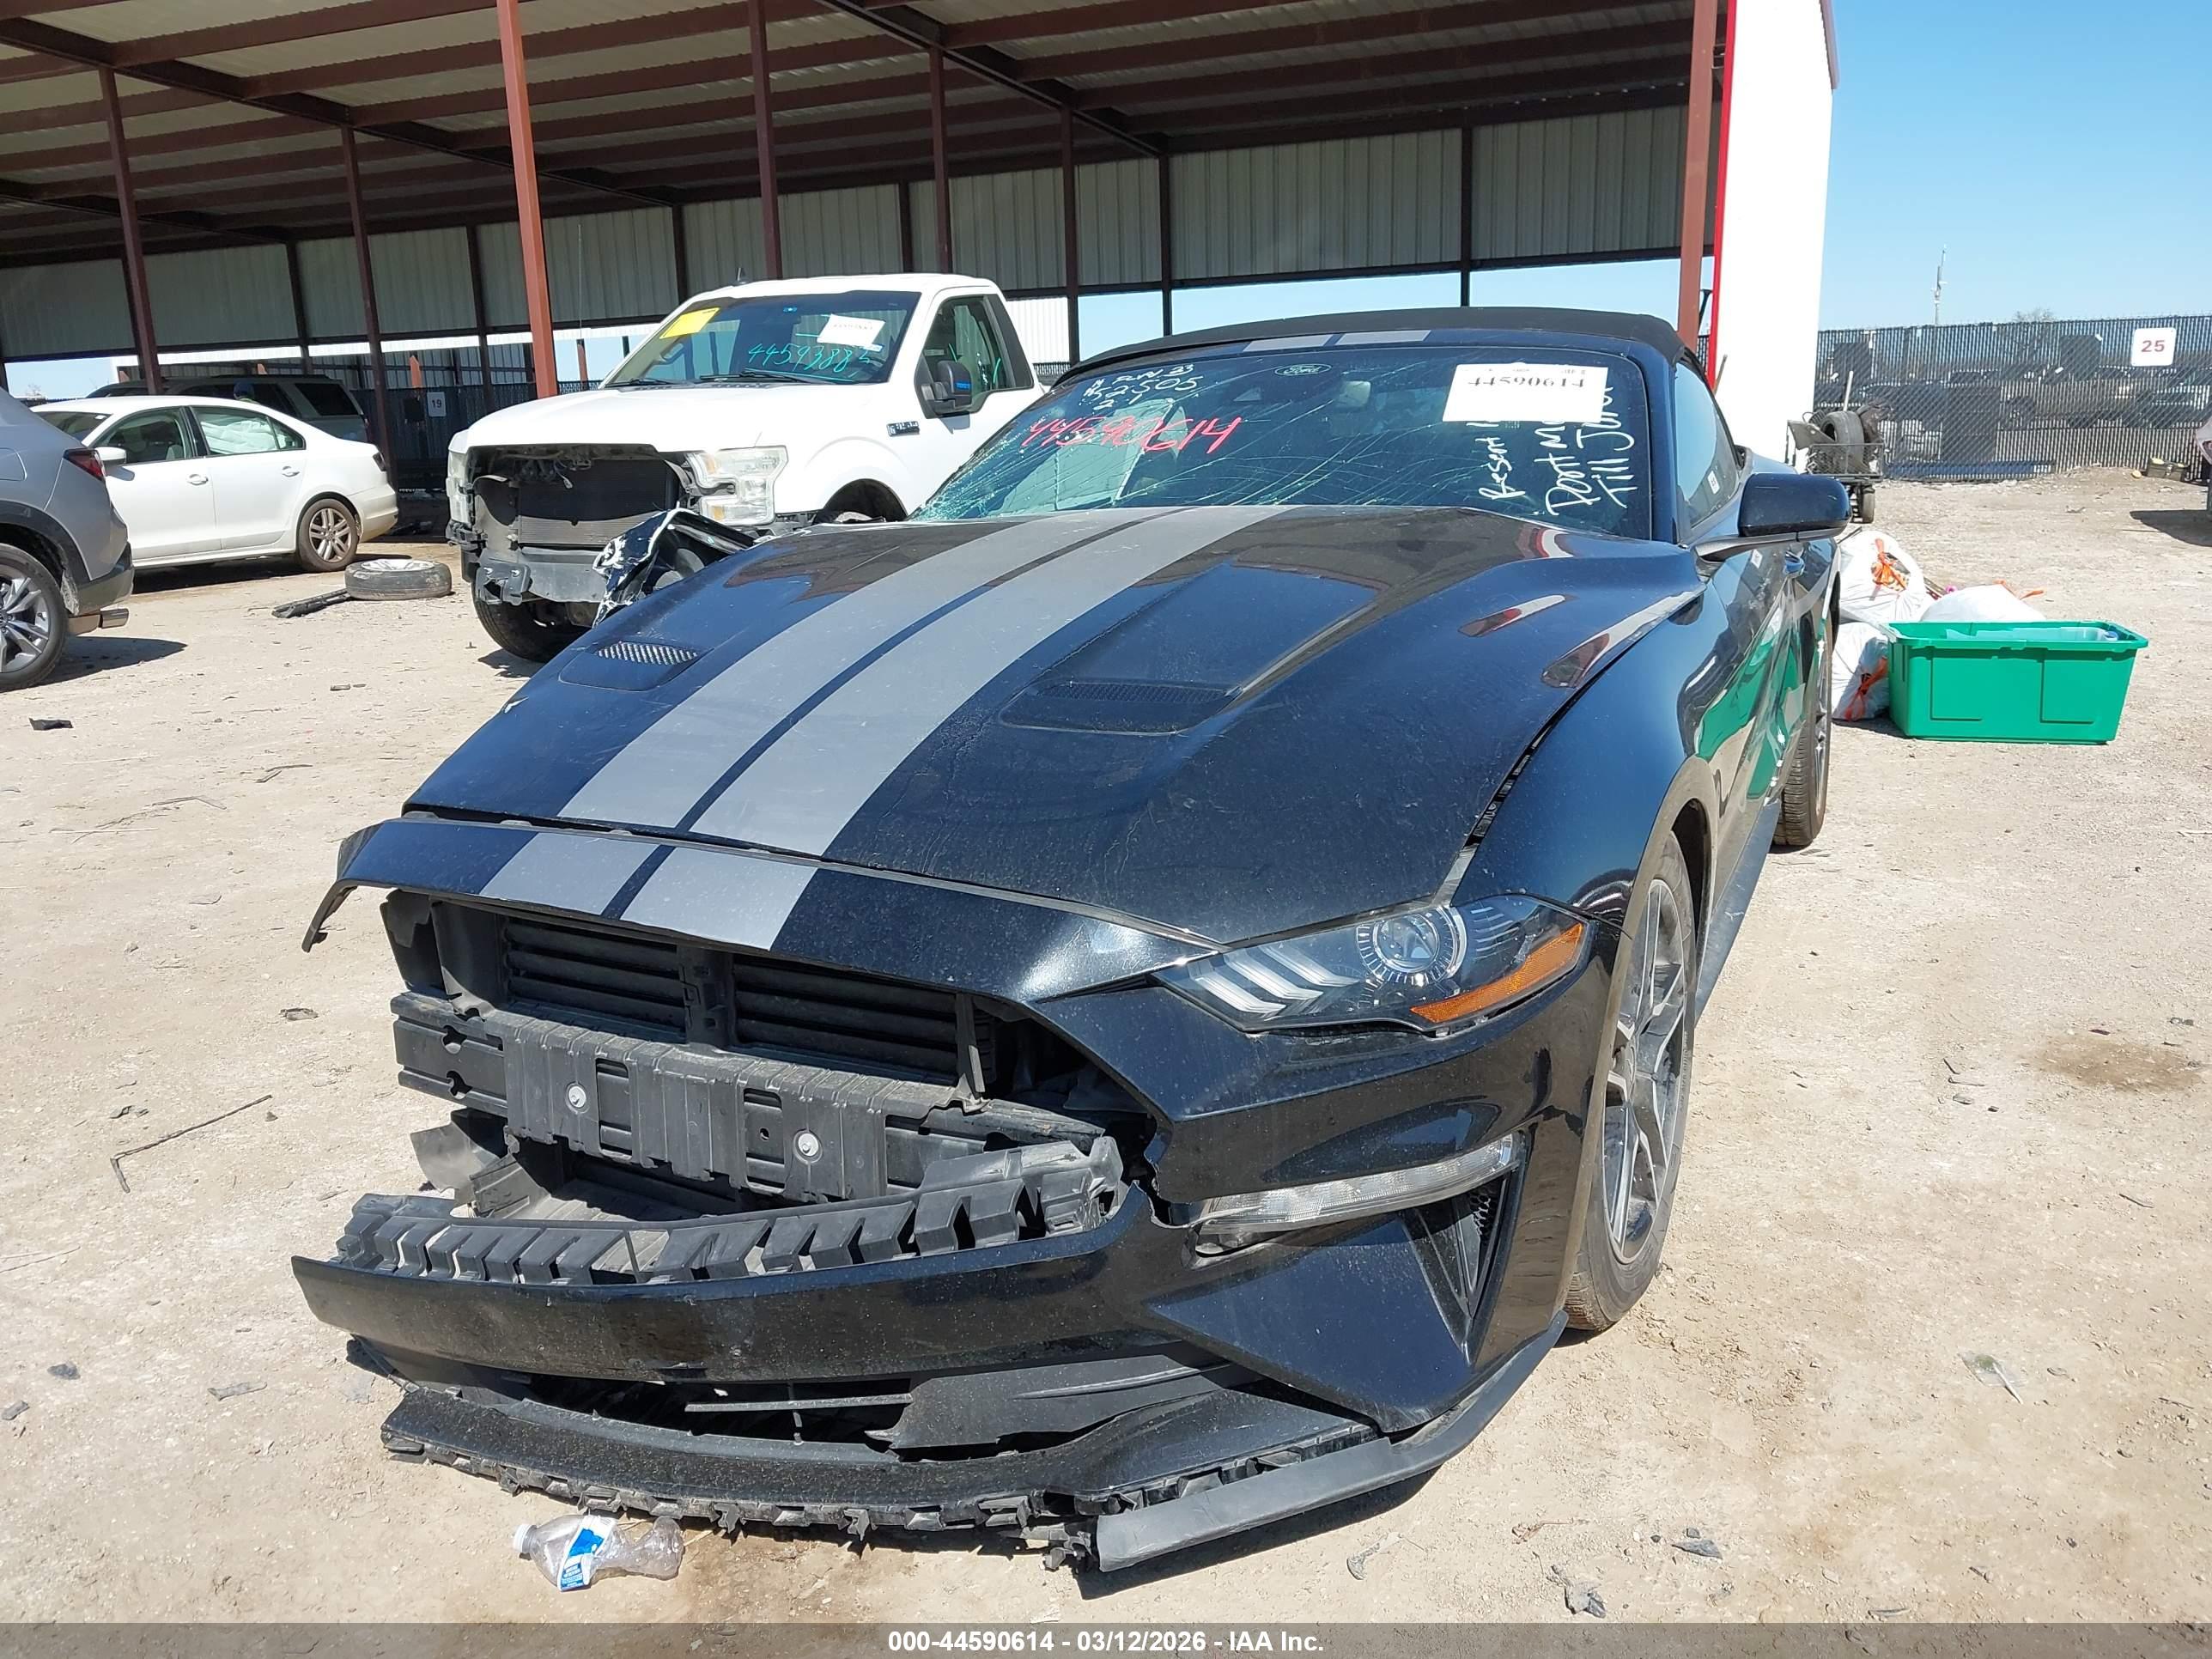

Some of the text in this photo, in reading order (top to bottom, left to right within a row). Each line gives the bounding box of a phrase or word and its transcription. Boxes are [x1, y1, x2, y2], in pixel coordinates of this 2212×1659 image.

[2141, 339, 2166, 352] 25
[431, 398, 442, 409] 19
[1586, 458, 1638, 508] Till
